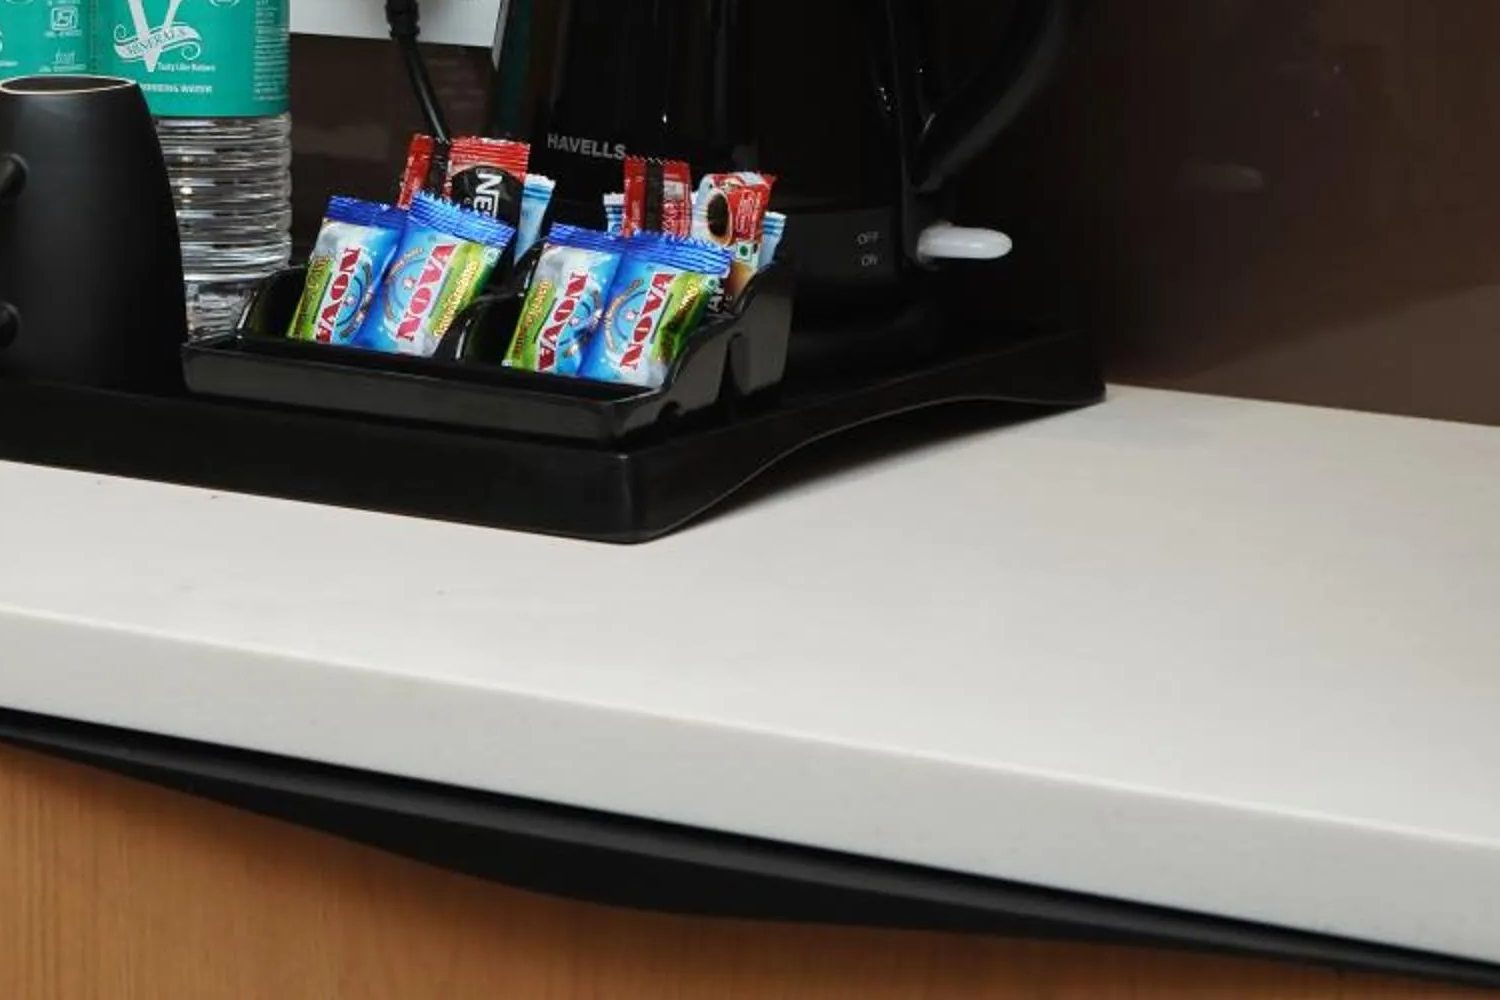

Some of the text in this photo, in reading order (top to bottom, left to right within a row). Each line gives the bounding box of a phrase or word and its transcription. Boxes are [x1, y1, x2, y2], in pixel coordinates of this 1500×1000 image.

[547, 133, 627, 160] HAVELLS
[857, 231, 880, 245] OFF
[861, 253, 879, 267] ON
[315, 247, 362, 344] NOVA
[396, 244, 457, 341] NOVA
[536, 271, 590, 371] NOVA
[619, 273, 677, 371] NOVA
